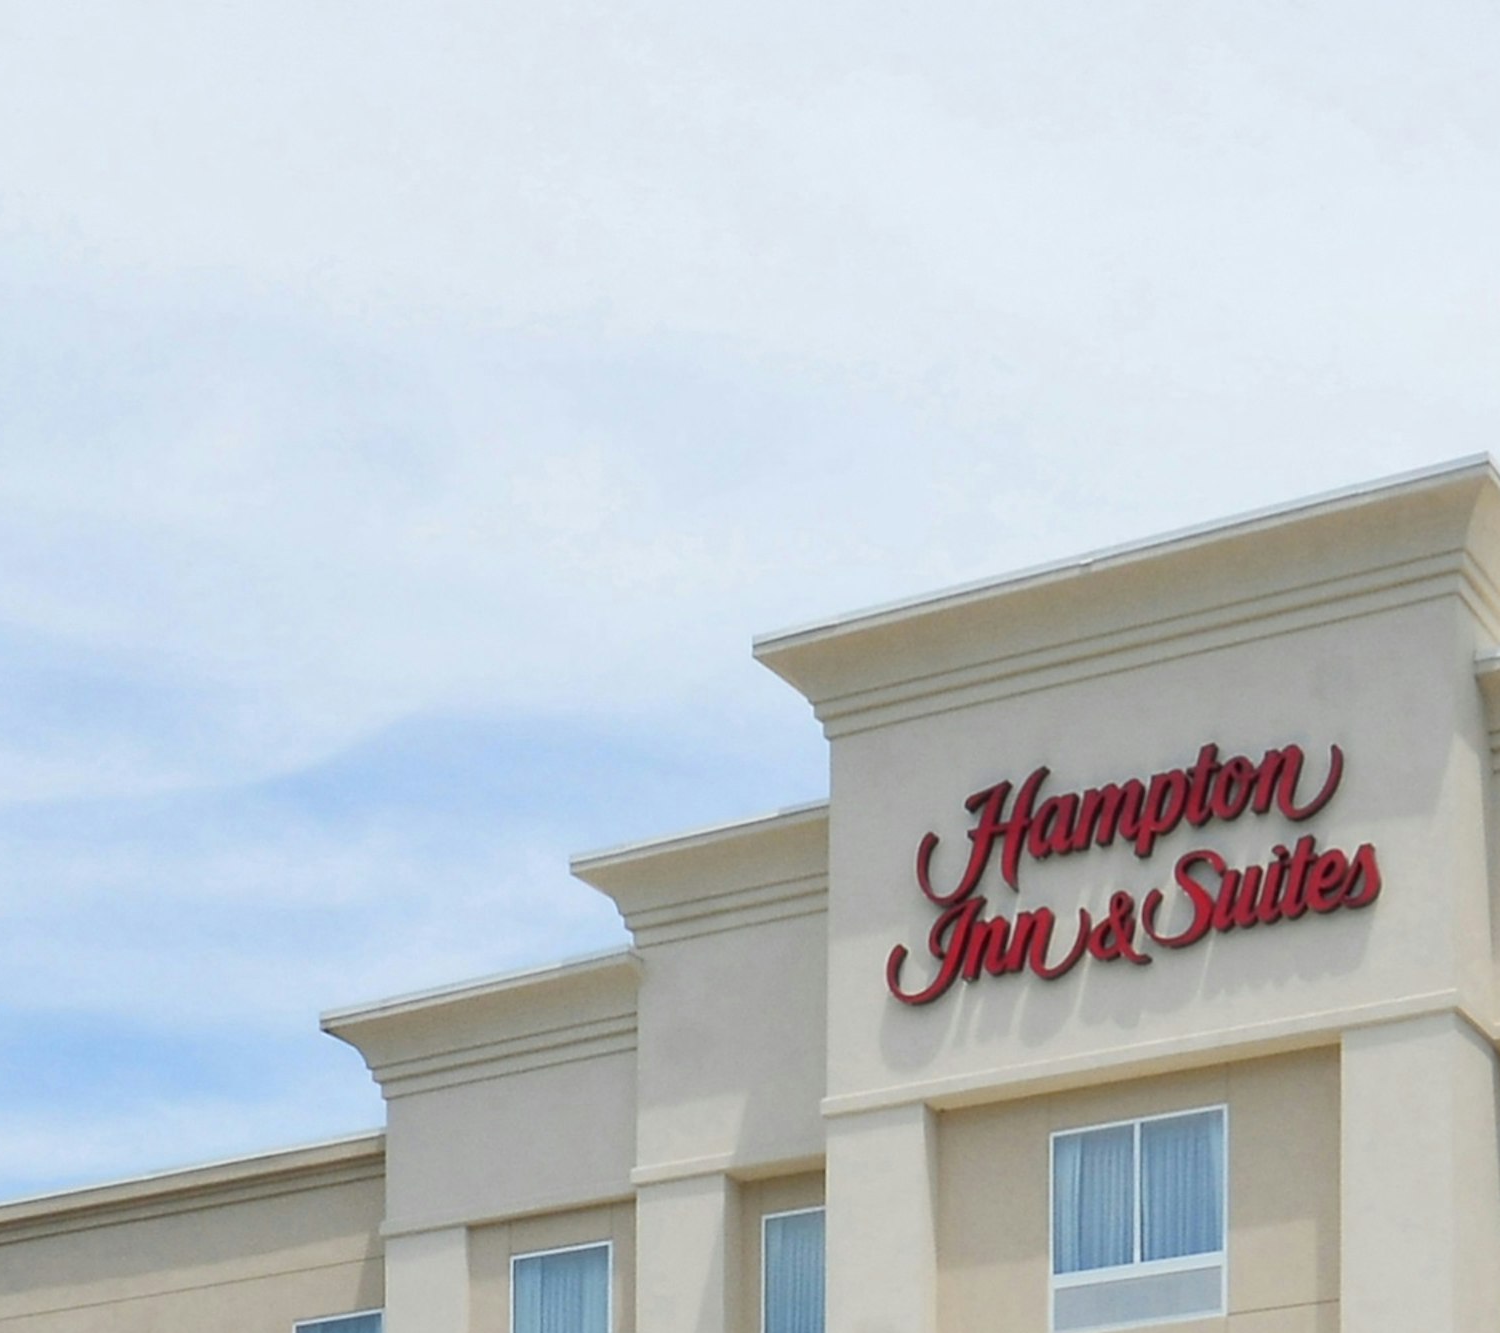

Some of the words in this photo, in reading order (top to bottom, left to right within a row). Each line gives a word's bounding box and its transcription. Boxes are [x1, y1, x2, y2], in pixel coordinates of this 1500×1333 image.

[916, 742, 1344, 907] Hampton
[886, 896, 1092, 1005] Inn
[1087, 890, 1152, 965] &
[1141, 834, 1382, 949] Suites
